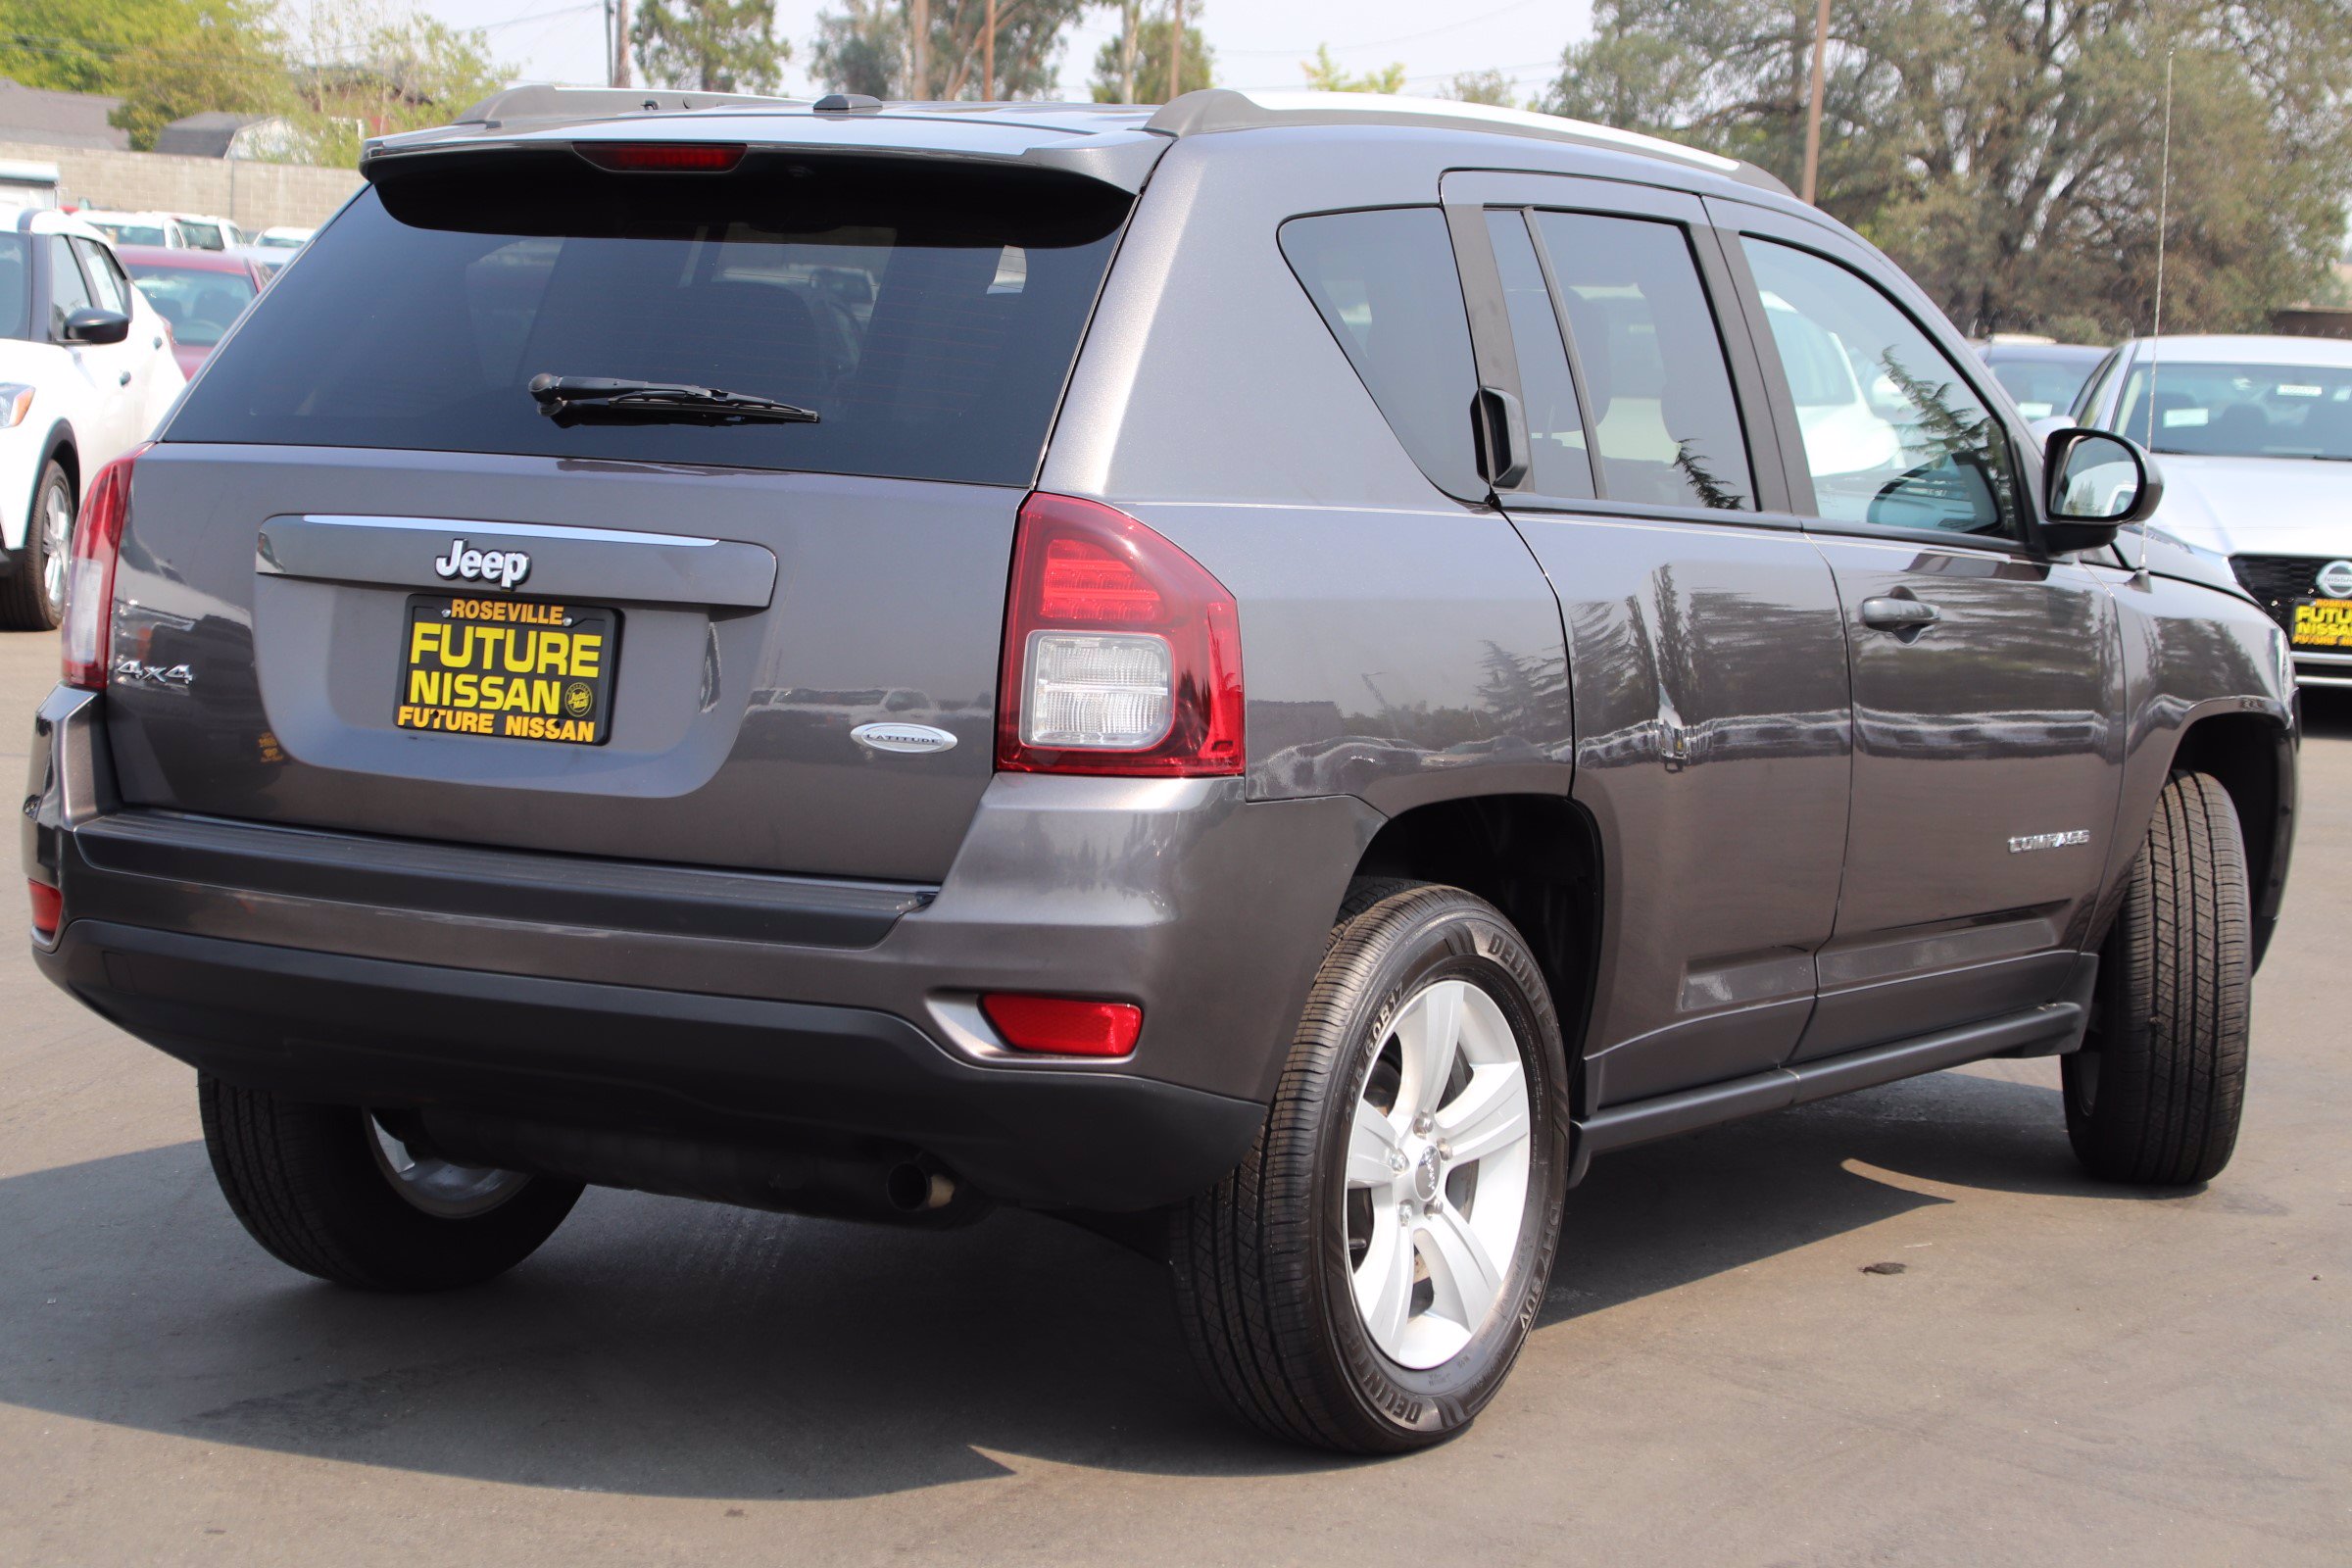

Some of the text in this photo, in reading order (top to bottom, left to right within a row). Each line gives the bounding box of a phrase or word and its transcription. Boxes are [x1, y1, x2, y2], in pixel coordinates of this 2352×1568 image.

[435, 539, 530, 590] Jeep
[451, 599, 564, 625] ROSEVILLE
[411, 622, 603, 678] FUTURE
[410, 670, 561, 715] NISSAN
[398, 706, 595, 742] FUTURE NISSAN
[866, 733, 940, 744] LATITUDE
